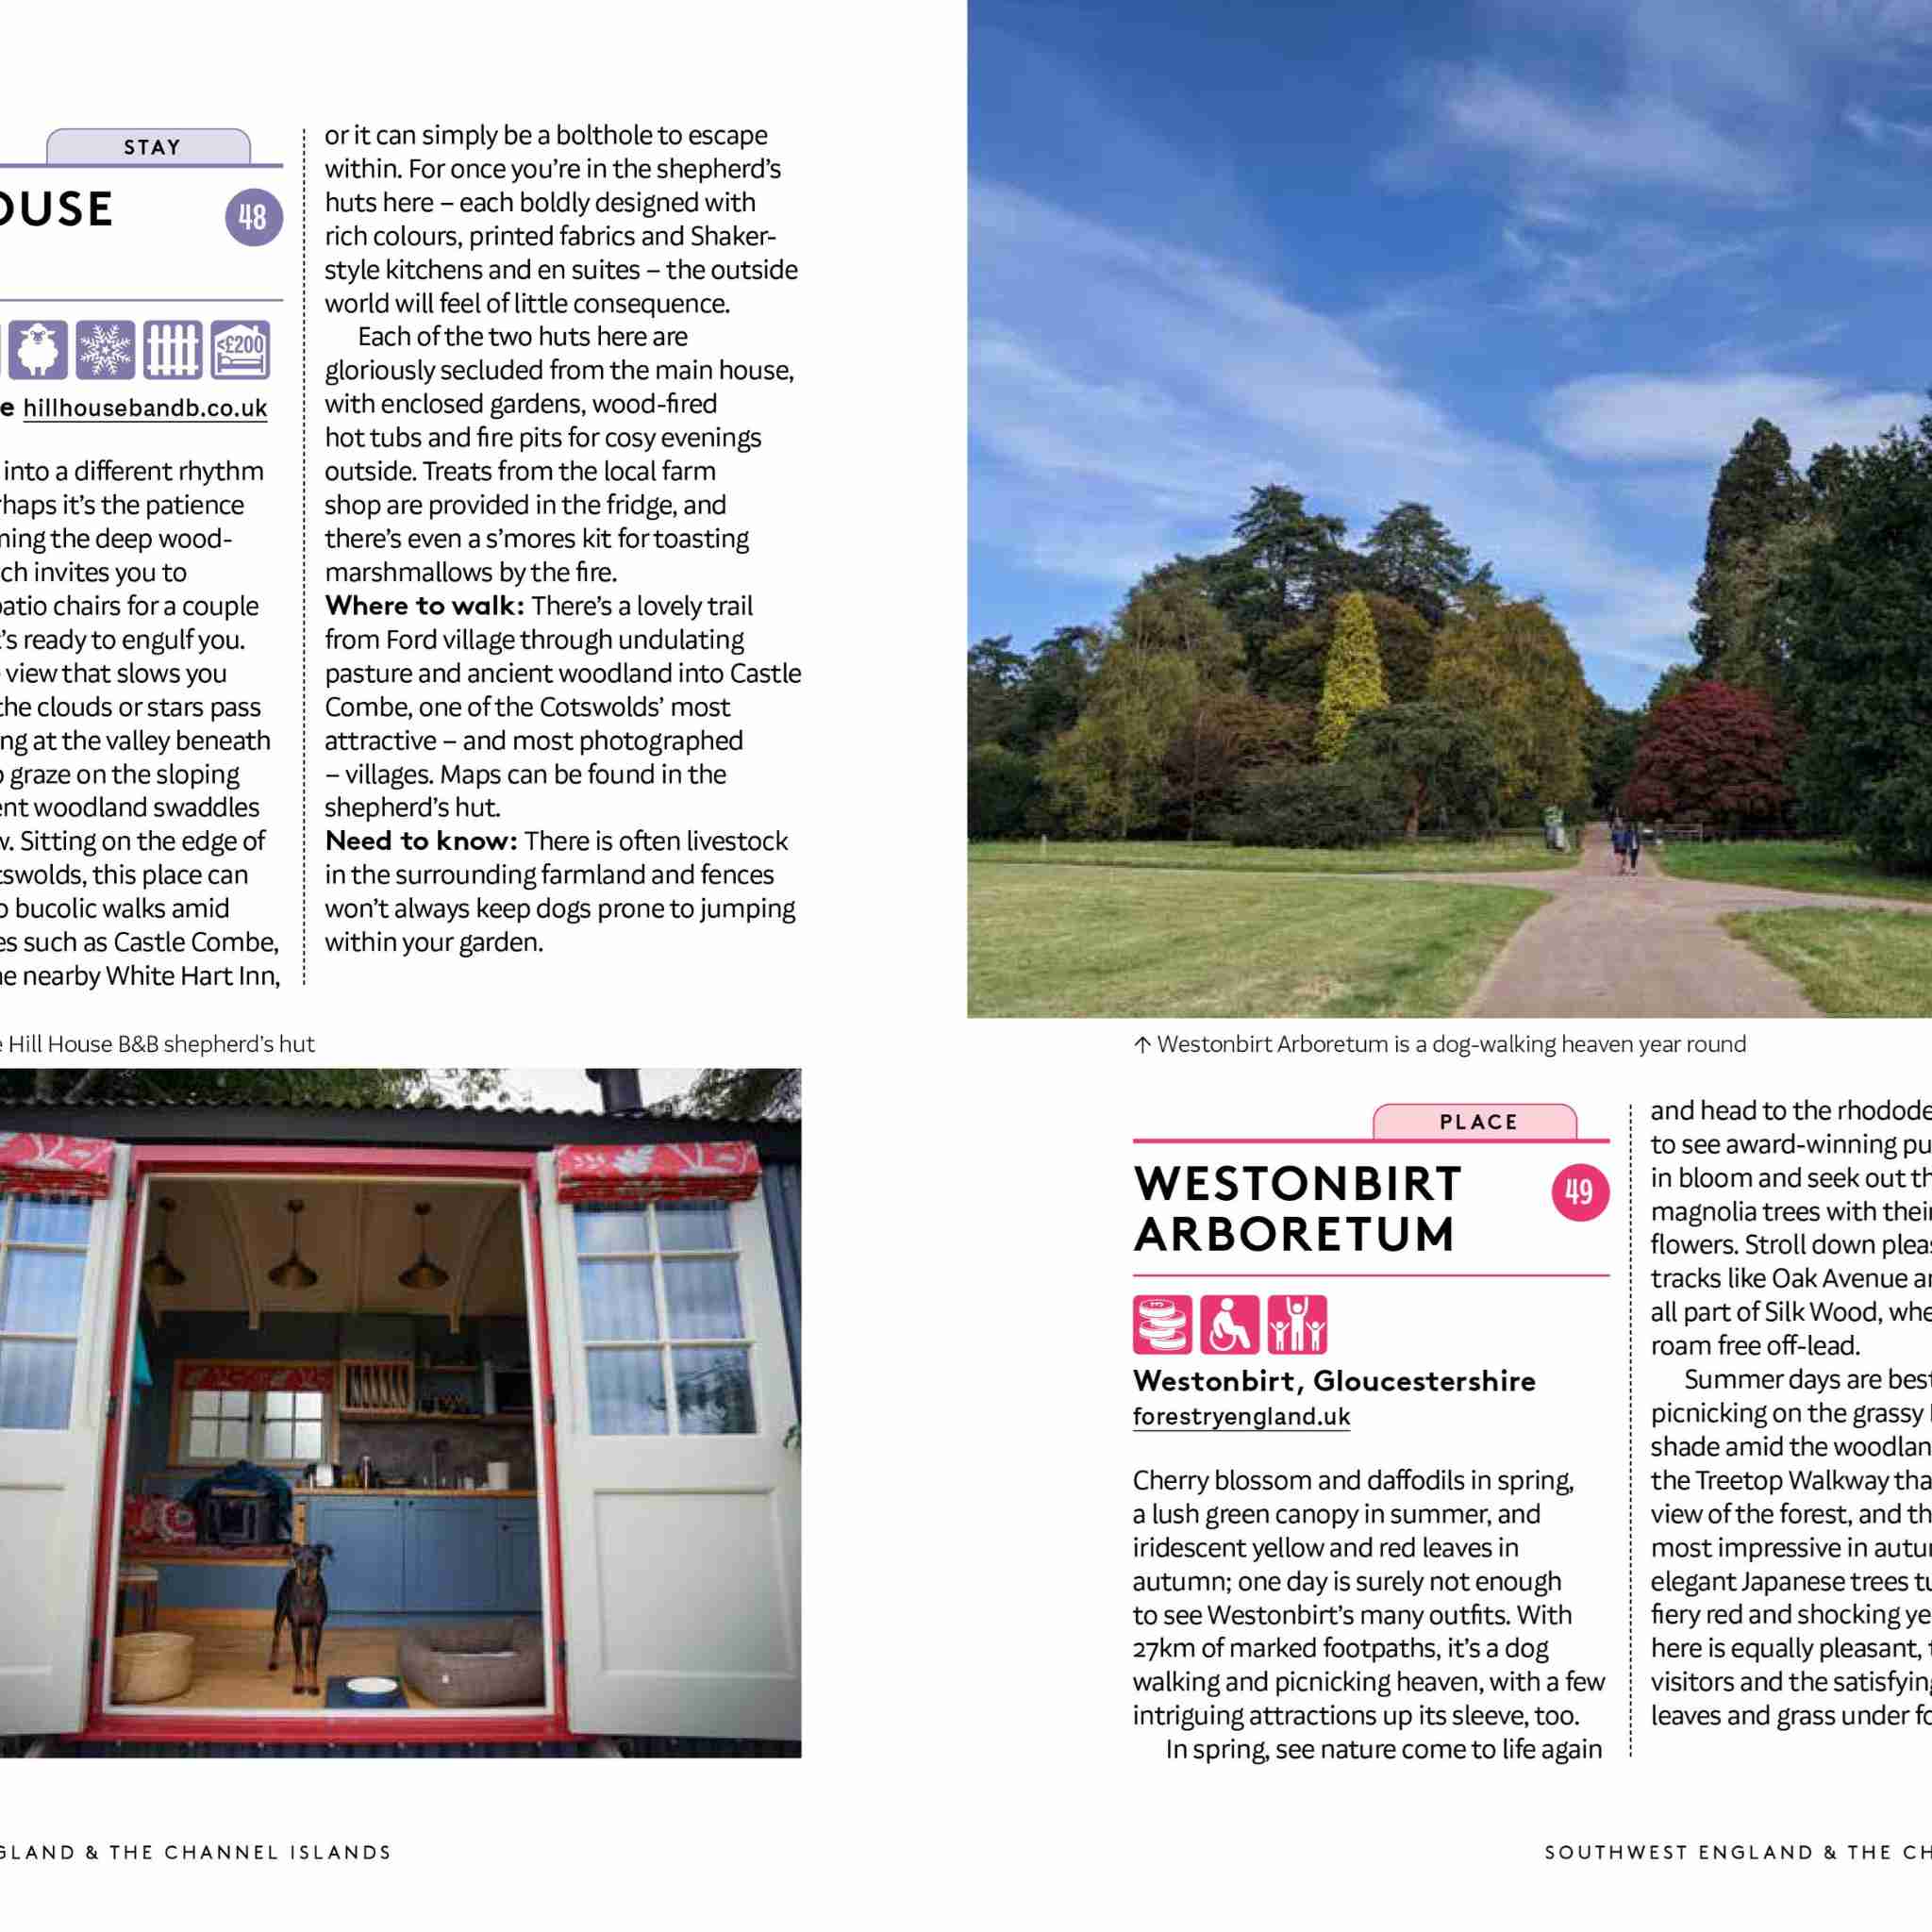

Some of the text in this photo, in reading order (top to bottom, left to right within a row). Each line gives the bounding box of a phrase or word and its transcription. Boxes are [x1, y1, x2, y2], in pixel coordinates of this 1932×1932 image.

[124, 139, 180, 156] STAY
[325, 123, 768, 151] or it can simply be a bolthole to escape
[238, 203, 268, 231] 48
[325, 224, 776, 252] rich colours, printed fabrics and Shaker-
[24, 397, 268, 418] hillhousebandb.co.uk
[325, 391, 717, 420] with enclosed gardens, wood-fired
[4, 458, 264, 487] into a different rhythm
[325, 492, 726, 521] shop are provided in the fridge, and
[34, 560, 109, 583] invites
[115, 566, 156, 588] you
[161, 563, 188, 583] to
[325, 594, 754, 622] Where to walk: There’s a lovely trail
[325, 627, 745, 656] from Ford village through undulating
[5, 661, 226, 689] view that slows you
[33, 731, 58, 751] at
[61, 728, 102, 751] the
[106, 728, 171, 756] valley
[176, 728, 271, 751] beneath
[326, 828, 789, 852] Need to know: There is often livestock
[16, 896, 97, 919] bucolic
[102, 896, 166, 919] walks
[172, 896, 229, 919] amid
[9, 1033, 42, 1053] Hill
[48, 1035, 113, 1054] House
[119, 1034, 159, 1054] B&B
[163, 1033, 275, 1058] shepherd’s
[279, 1033, 316, 1054] hut
[1157, 1033, 1746, 1058] Westonbirt Arboretum is a dog-walking heaven year round
[1441, 1113, 1517, 1130] PLACE
[1650, 1135, 1676, 1155] to
[1682, 1138, 1722, 1155] see
[1725, 1132, 1898, 1160] award-winning
[1134, 1165, 1462, 1202] WESTONBIRT
[1564, 1177, 1594, 1207] 49
[1133, 1215, 1453, 1253] ARBORETUM
[1652, 1333, 1860, 1357] roam free off-lead.
[1132, 1368, 1536, 1396] Westonbirt, Gloucestershire
[1132, 1406, 1351, 1428] forestryengland.uk
[1651, 1435, 1721, 1457] shade
[1725, 1435, 1784, 1457] amid
[1789, 1435, 1828, 1457] the
[1133, 1468, 1574, 1496] Cherry blossom and daffodils in spring,
[1650, 1469, 1691, 1491] the
[1694, 1470, 1783, 1495] Treetop
[1788, 1469, 1890, 1495] Walkway
[1650, 1503, 1704, 1524] view
[1707, 1502, 1733, 1524] of
[1735, 1502, 1774, 1524] the
[1779, 1502, 1853, 1527] forest,
[1858, 1502, 1902, 1524] and
[1133, 1536, 1519, 1563] iridescent yellow and red leaves in
[1650, 1602, 1702, 1630] fiery
[1707, 1603, 1743, 1625] red
[1748, 1603, 1792, 1625] and
[1797, 1603, 1902, 1630] shocking
[1133, 1636, 1550, 1664] 27km of marked footpaths, it’s a dog
[1133, 1704, 1580, 1732] intriguing attractions up its sleeve, too.
[85, 1844, 99, 1860] &
[108, 1844, 152, 1860] THE
[164, 1844, 278, 1860] CHANNEL
[291, 1844, 390, 1860] ISLANDS
[1545, 1844, 1688, 1860] SOUTHWEST
[1699, 1844, 1812, 1860] ENGLAND
[1824, 1844, 1837, 1860] &
[1847, 1844, 1890, 1860] THE
